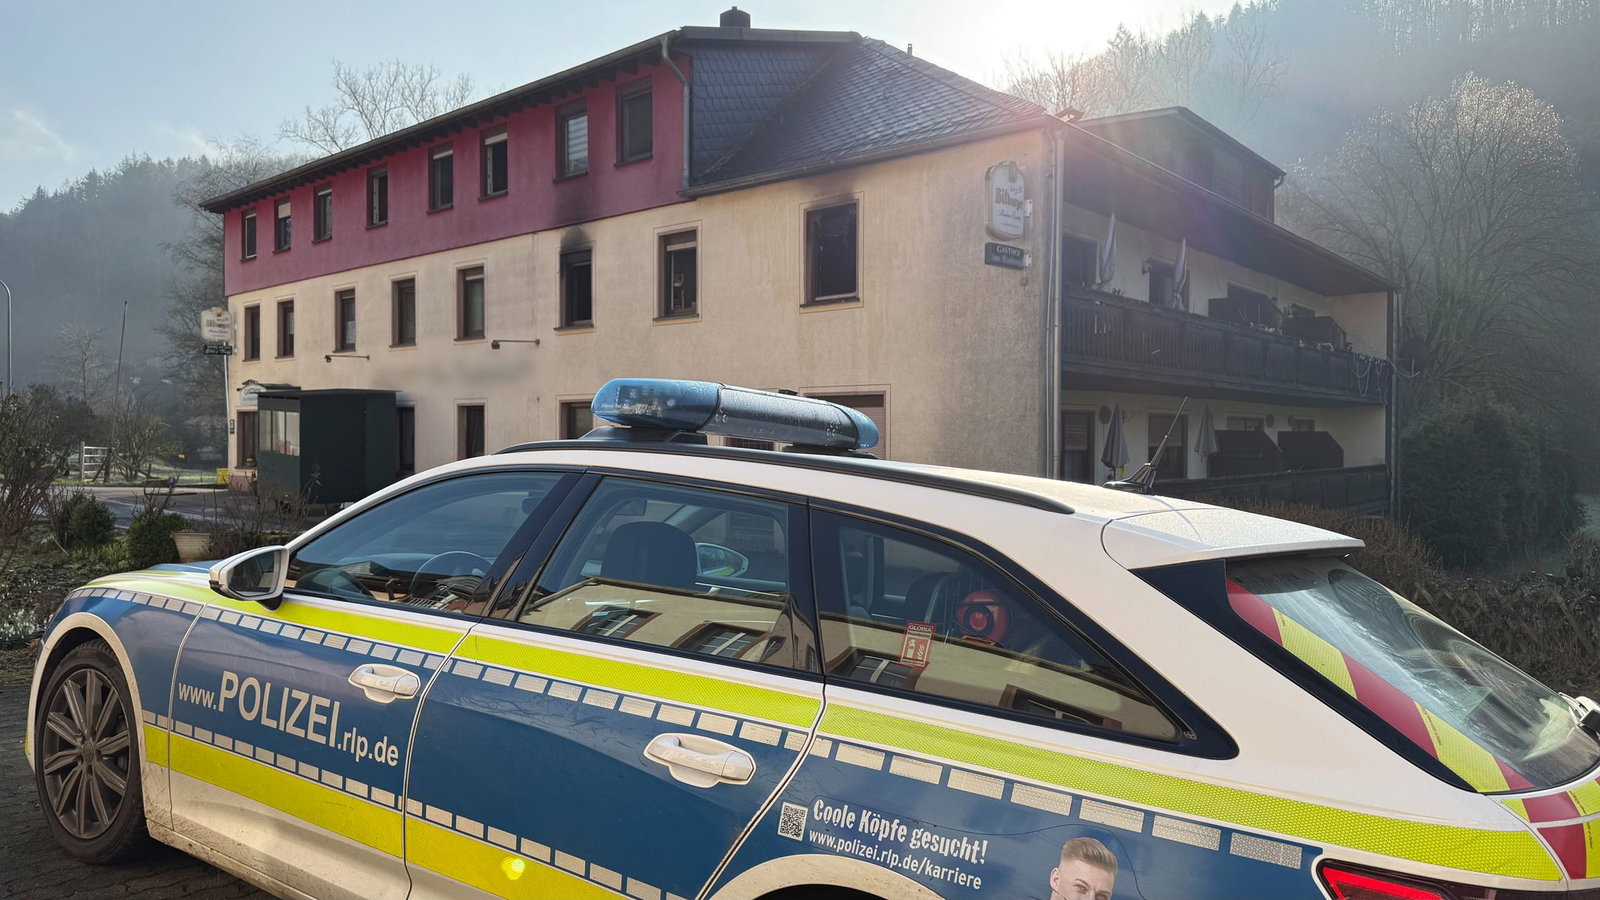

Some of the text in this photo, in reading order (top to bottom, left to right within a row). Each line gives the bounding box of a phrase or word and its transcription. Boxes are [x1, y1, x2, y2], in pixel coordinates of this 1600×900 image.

[178, 671, 399, 767] www.POLIZEI.rlp.de
[809, 830, 982, 890] www.polizei.rlp.de/karriere
[813, 799, 988, 865] Coole Köpfe gesucht!
